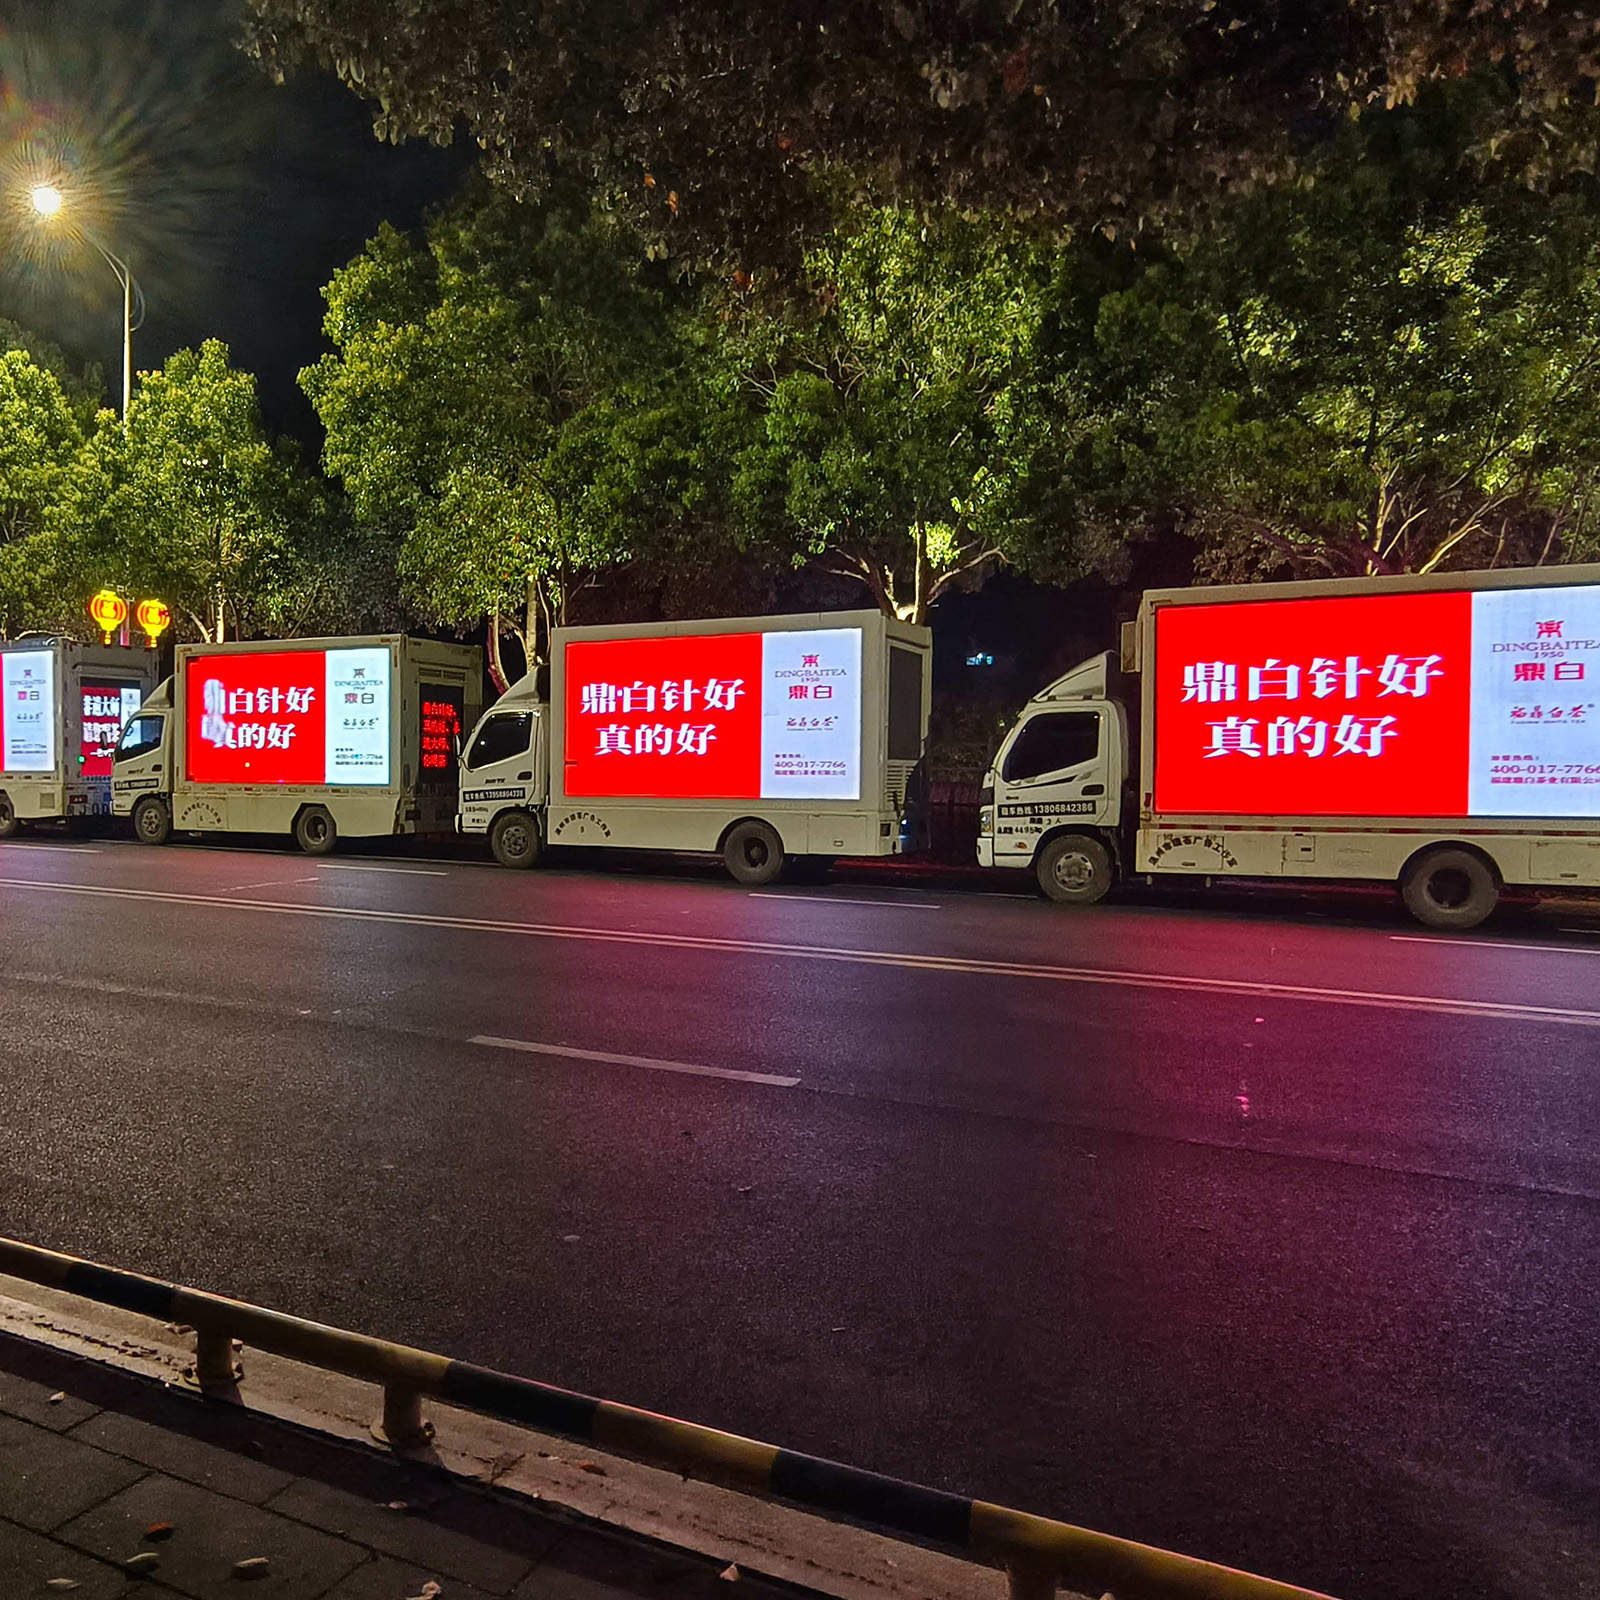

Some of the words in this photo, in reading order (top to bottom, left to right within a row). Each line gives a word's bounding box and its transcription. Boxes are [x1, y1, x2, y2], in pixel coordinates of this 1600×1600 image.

[1180, 654, 1445, 703] 鼎白针好
[1513, 661, 1585, 682] 鼎白
[203, 680, 316, 715] 白针好
[580, 678, 746, 714] 鼎白针好
[788, 685, 832, 699] 鼎白
[594, 723, 717, 755] 真的好
[1202, 714, 1399, 758] 真的好
